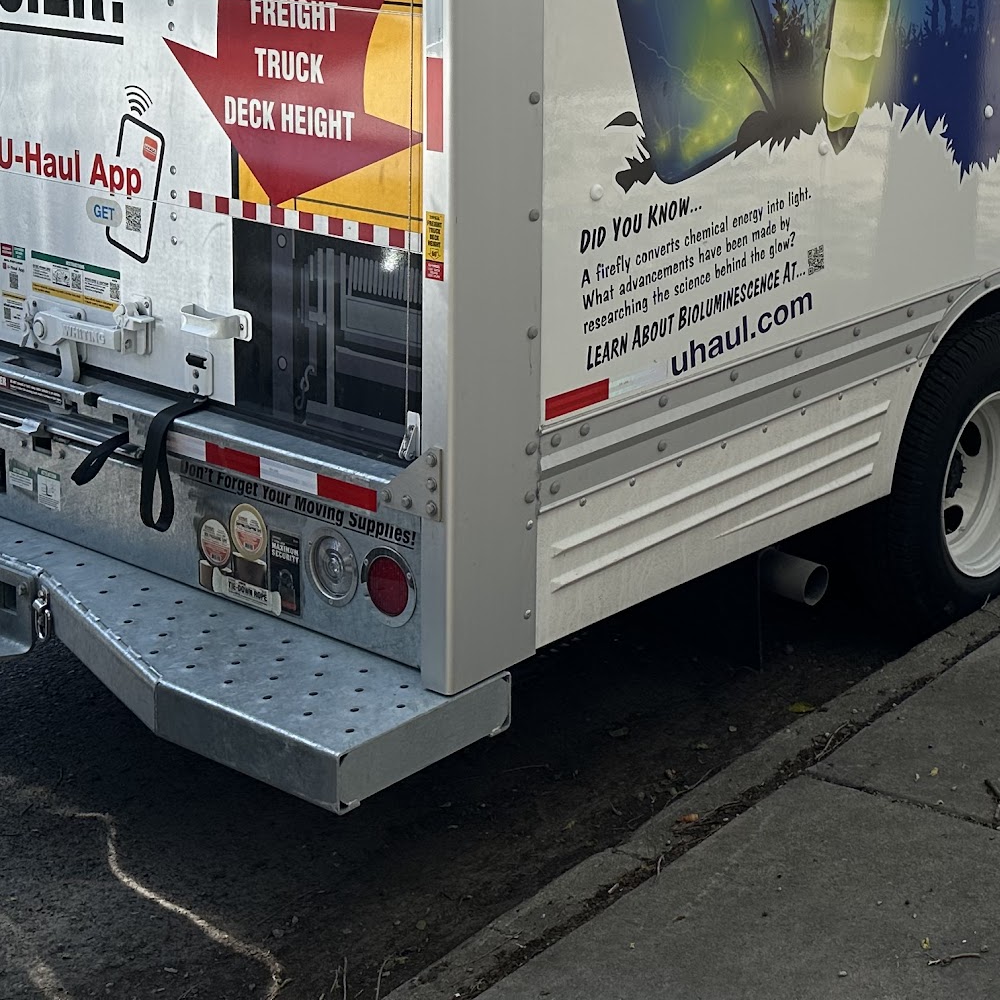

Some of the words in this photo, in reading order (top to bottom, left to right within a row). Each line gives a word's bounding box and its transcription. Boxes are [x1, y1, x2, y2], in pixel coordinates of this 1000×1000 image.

[254, 47, 325, 85] TRUCK
[224, 95, 276, 132] DECK
[281, 102, 355, 142] HEIGHT
[0, 136, 81, 183] U-Haul
[89, 153, 142, 199] App
[93, 204, 115, 221] GET
[579, 225, 607, 255] DID
[612, 212, 643, 242] YOU
[581, 268, 591, 289] A
[596, 254, 631, 282] firefly
[635, 237, 681, 266] converts
[684, 215, 729, 247] chemical
[732, 206, 764, 229] energy
[767, 198, 785, 215] into
[788, 186, 812, 208] light.
[582, 284, 615, 310] What
[619, 254, 695, 296] advancements
[698, 245, 722, 264] have
[725, 233, 748, 253] been
[751, 219, 777, 242] made
[779, 215, 791, 232] by
[583, 297, 649, 335] researching
[652, 286, 670, 305] the
[674, 271, 711, 296] science
[714, 251, 747, 279] behind
[750, 246, 766, 265] the
[769, 231, 796, 260] glow?
[586, 332, 629, 372] LEARN
[631, 312, 675, 351] ABOUT
[678, 268, 780, 332] BIOLUMINESCENCE
[671, 291, 813, 377] uhaul.com
[180, 460, 214, 481] Don't
[216, 470, 258, 497] Forget
[262, 487, 291, 507] Your
[294, 495, 344, 528] Moving
[348, 511, 417, 546] Supplies!
